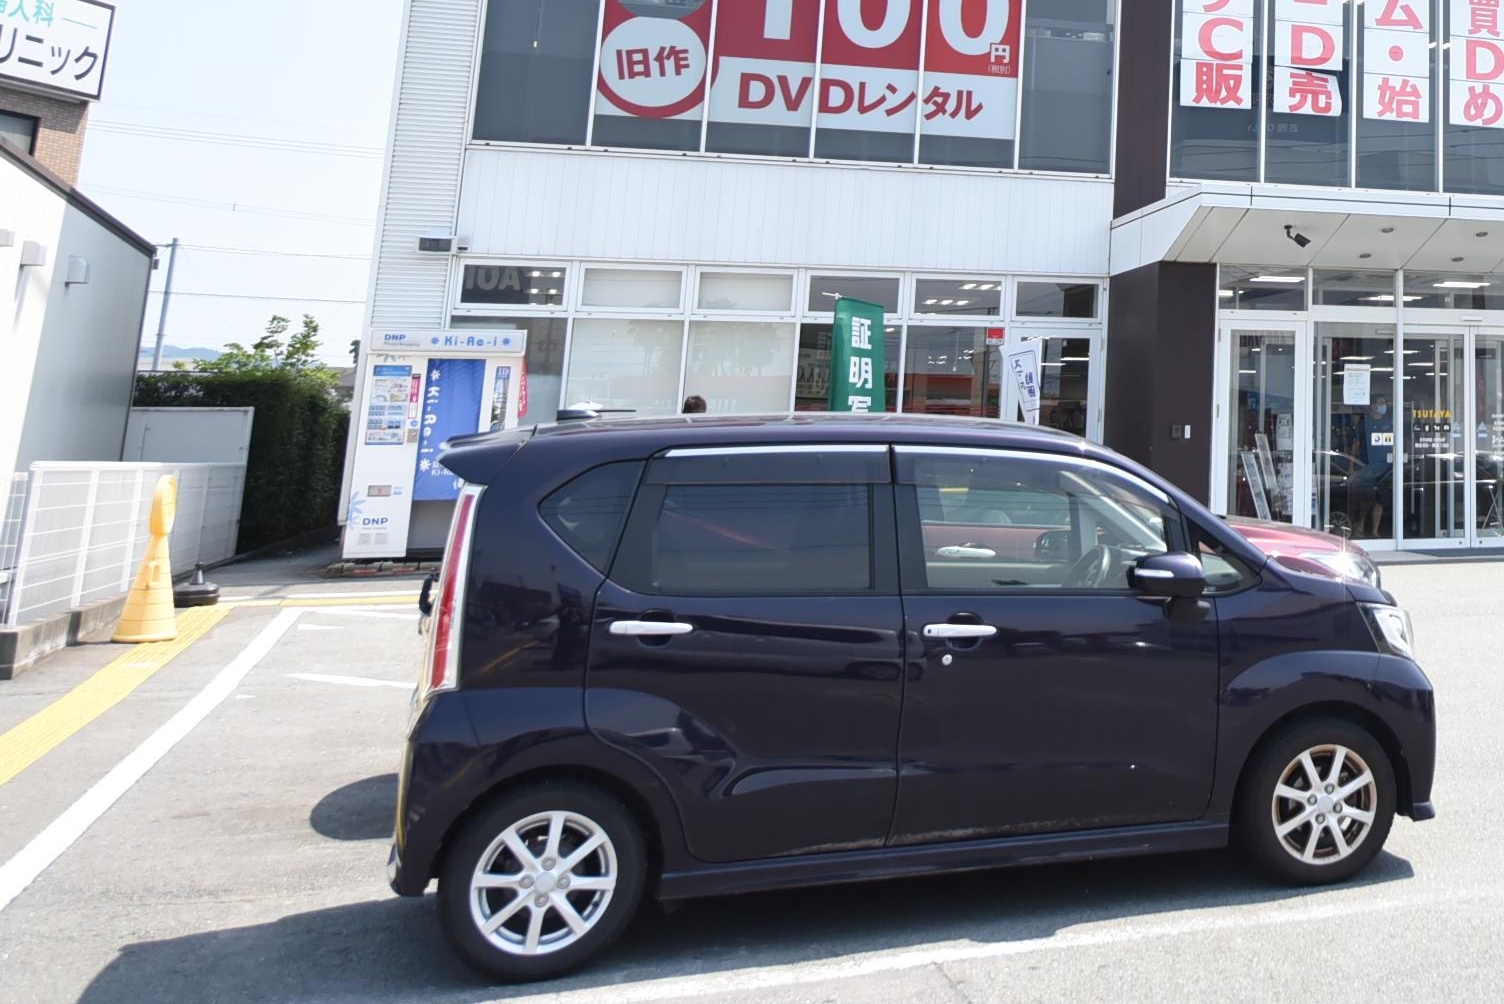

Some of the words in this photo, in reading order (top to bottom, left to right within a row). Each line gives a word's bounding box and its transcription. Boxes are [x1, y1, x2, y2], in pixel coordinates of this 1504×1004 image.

[615, 45, 692, 81] 旧作
[737, 72, 983, 122] DVDレンタル
[384, 333, 406, 341] DNP
[1412, 409, 1452, 419] TSUTAYA
[362, 517, 389, 526] DNP
